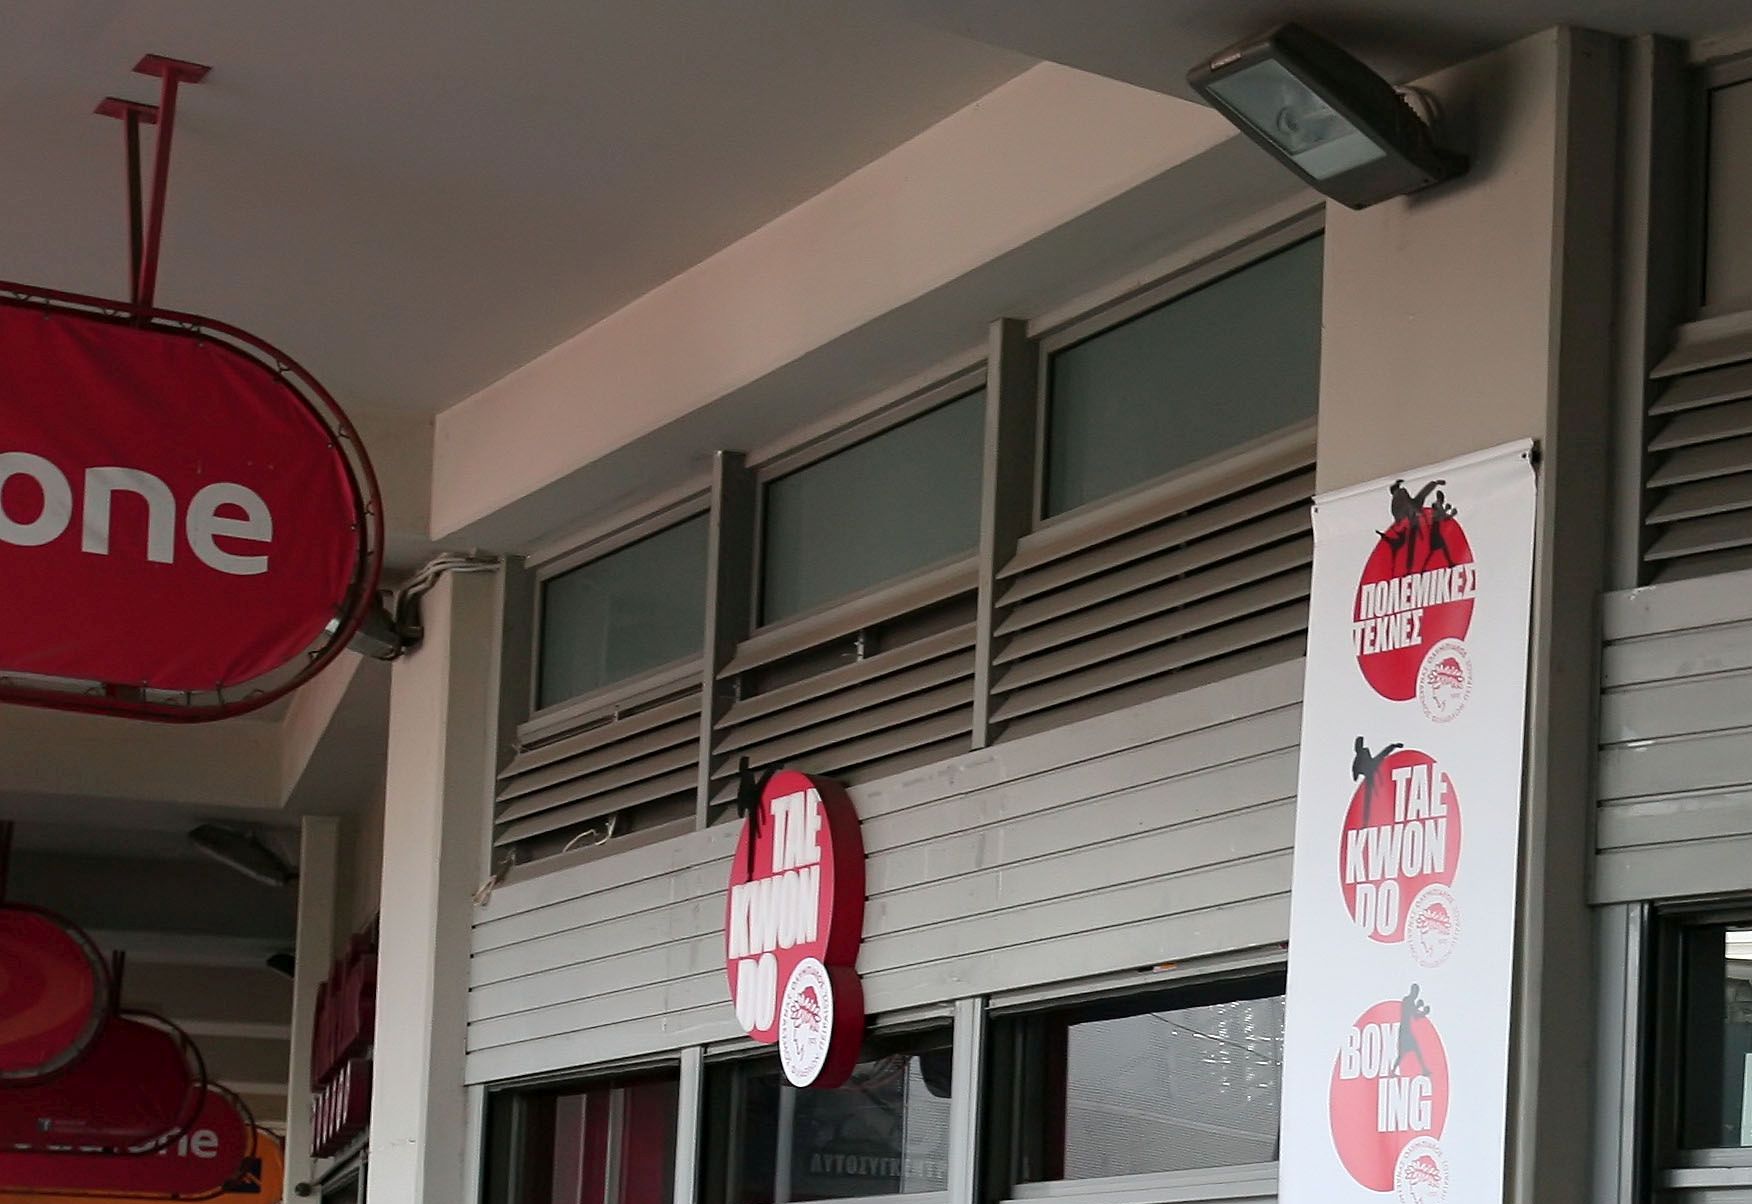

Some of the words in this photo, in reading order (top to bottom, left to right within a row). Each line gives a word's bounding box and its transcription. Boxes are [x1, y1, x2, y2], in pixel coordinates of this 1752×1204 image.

[1360, 562, 1477, 620] ΠΟΛΕΜΙΚΕΣ
[1352, 608, 1423, 656] ΤΕΧΝΕΣ
[1392, 764, 1449, 823] TAE
[771, 788, 822, 873] TAE
[1345, 817, 1447, 884] KWON
[729, 865, 820, 960] KWON
[1353, 880, 1400, 936] DO
[736, 953, 777, 1033] DO
[1340, 1022, 1402, 1080] BOX
[1377, 1075, 1432, 1132] ING
